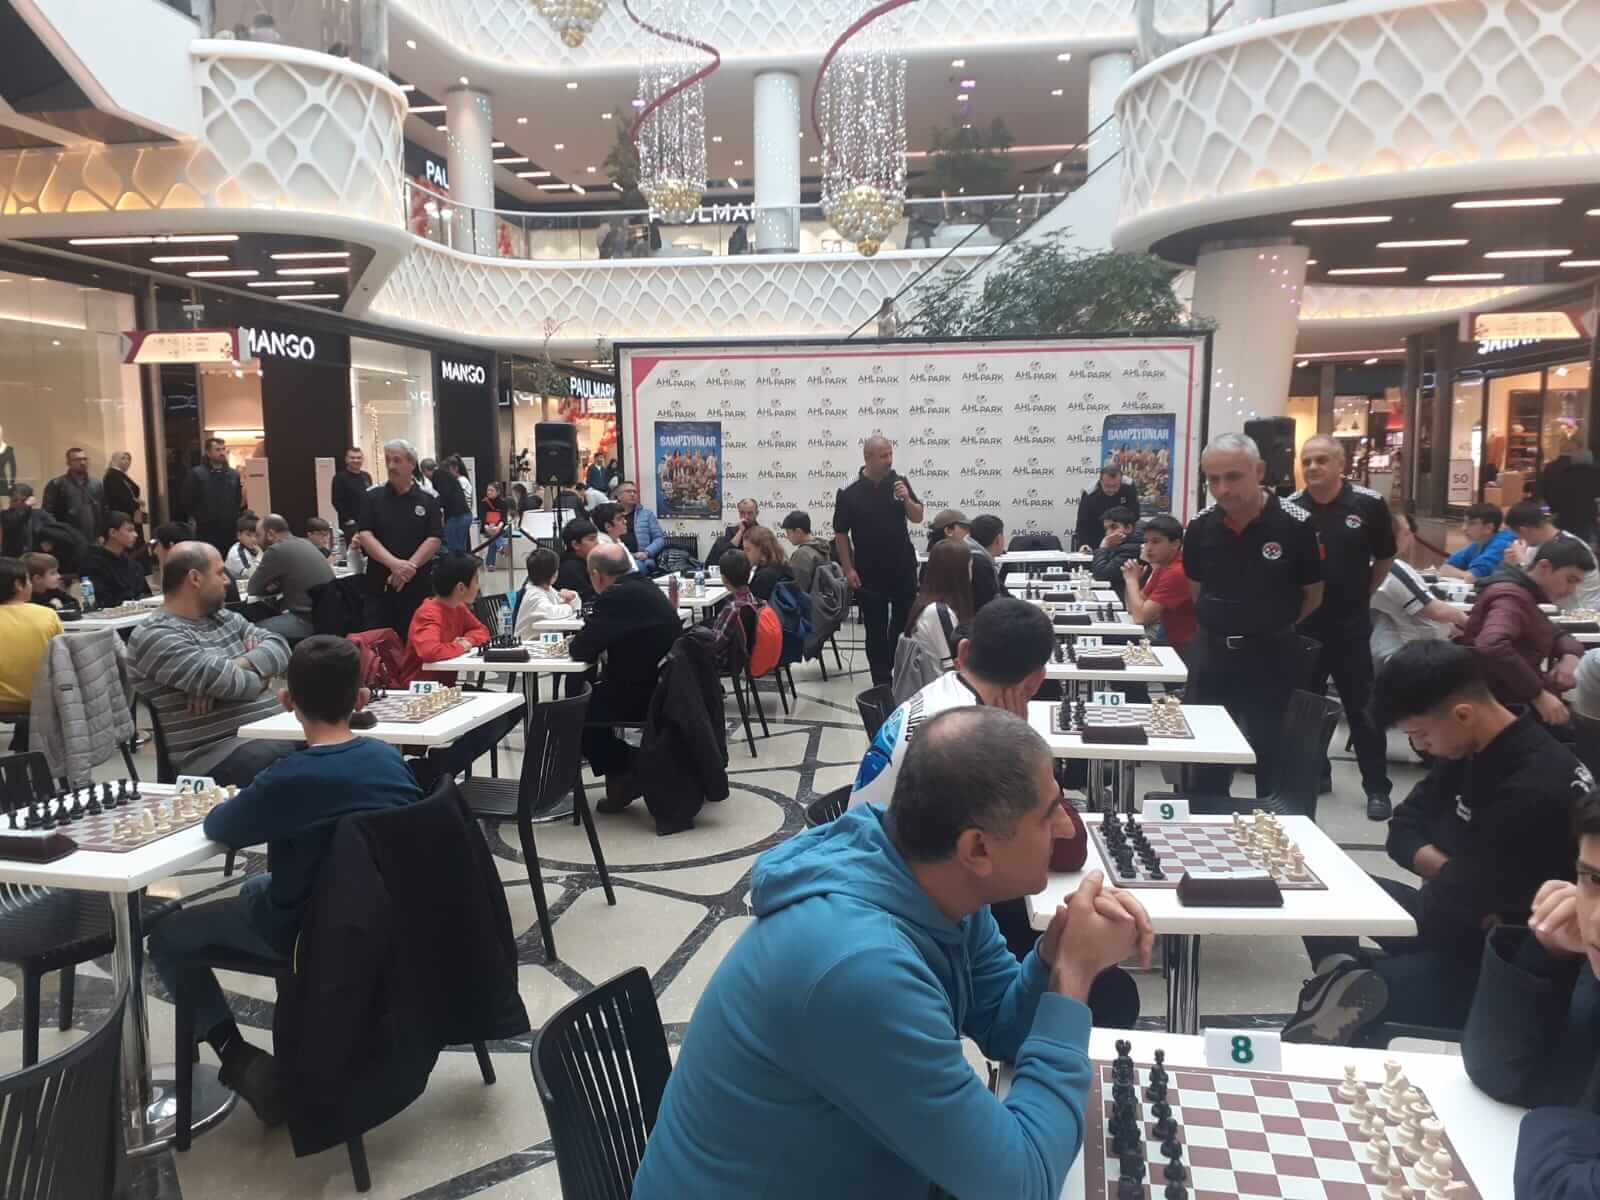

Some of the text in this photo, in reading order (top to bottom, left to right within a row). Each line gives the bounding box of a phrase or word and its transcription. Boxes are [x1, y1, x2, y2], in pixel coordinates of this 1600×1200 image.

[441, 359, 486, 384] MANGO
[1080, 638, 1097, 648] 11
[413, 683, 433, 694] 19
[1098, 694, 1120, 705] 10
[1160, 803, 1174, 820] 9
[1230, 1034, 1255, 1064] 8
